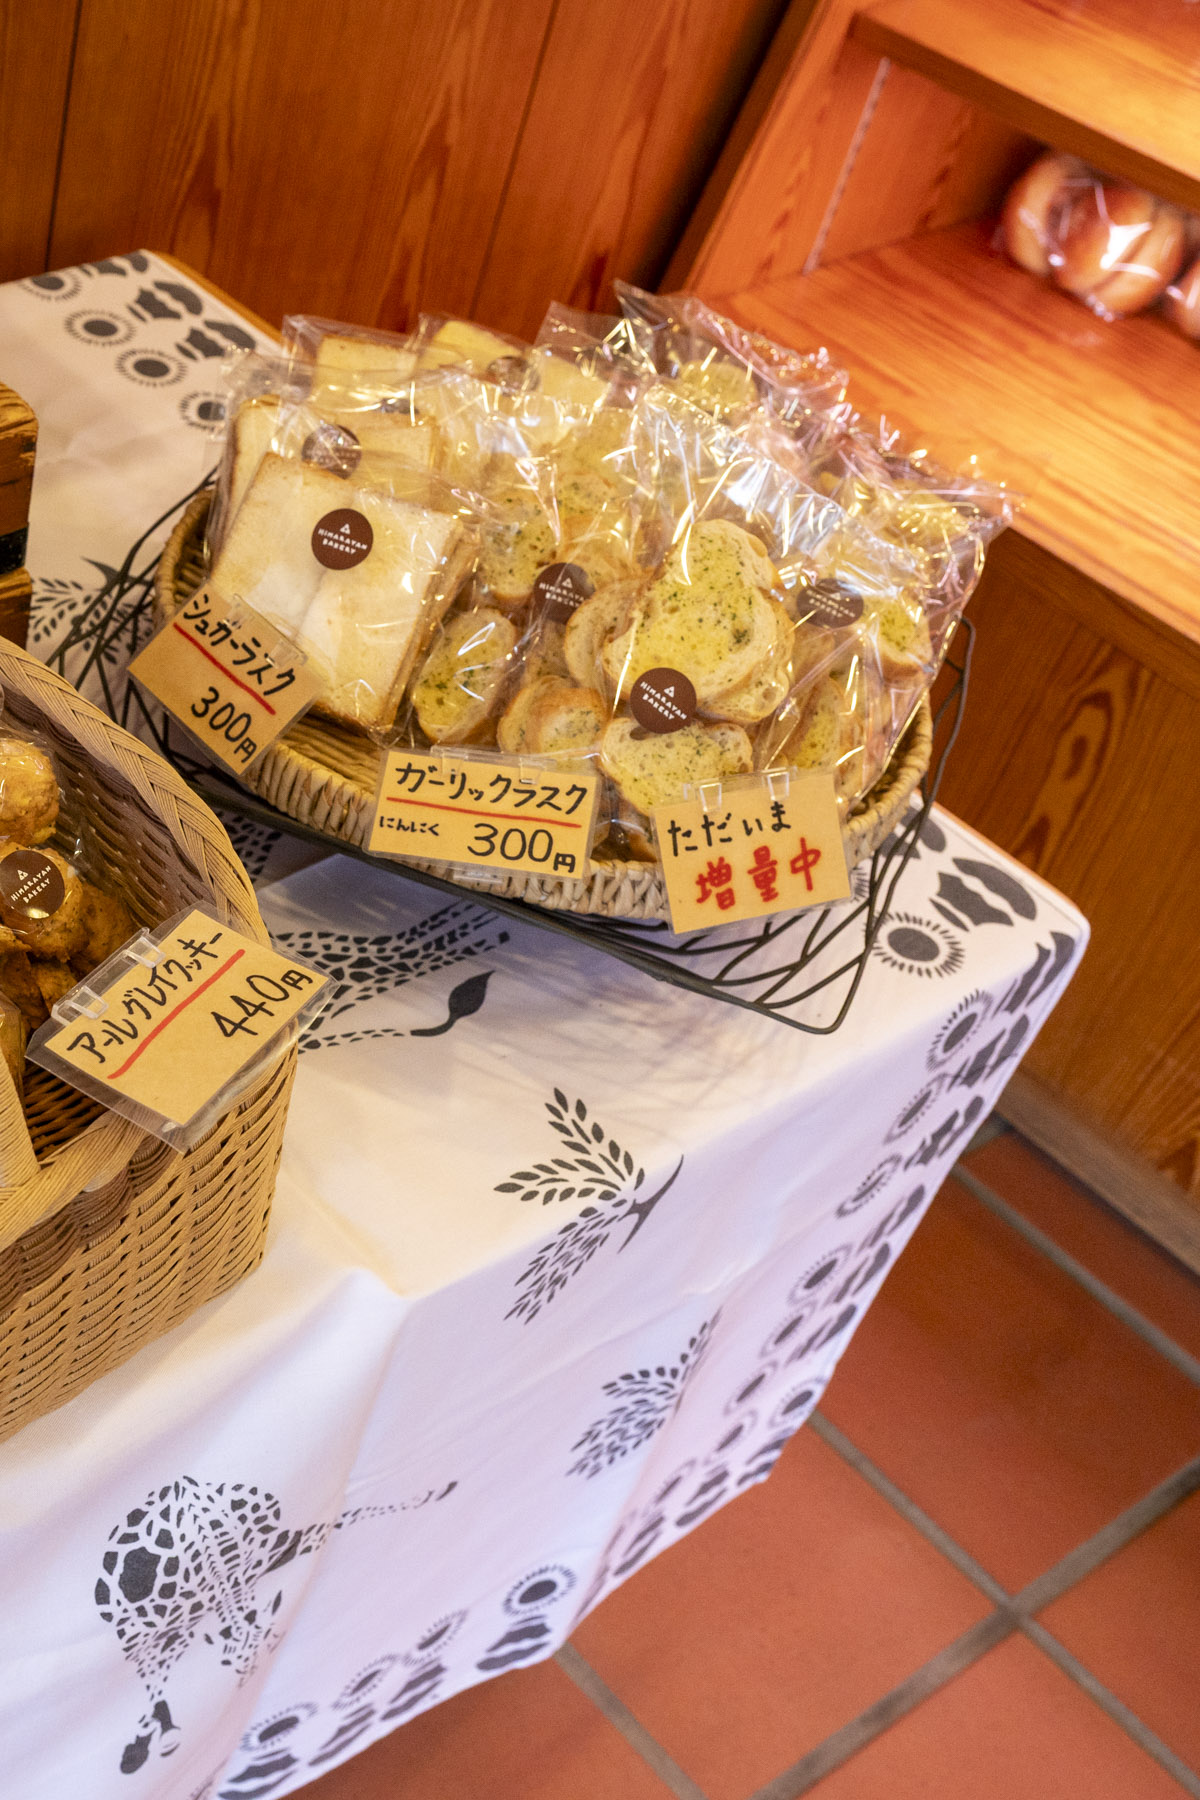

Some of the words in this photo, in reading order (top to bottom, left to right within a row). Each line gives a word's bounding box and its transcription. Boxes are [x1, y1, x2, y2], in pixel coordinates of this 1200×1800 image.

[183, 593, 296, 697] シュガーラスク
[190, 686, 258, 764] 300円
[395, 762, 588, 815] ガーリックラスク
[379, 815, 440, 837] にんにく
[467, 822, 577, 873] 300円
[667, 801, 792, 857] ただいま
[22, 878, 51, 904] BAKERY
[695, 837, 822, 910] 増量中
[66, 932, 224, 1064] アールグレイクッキー
[210, 969, 314, 1038] 440円
